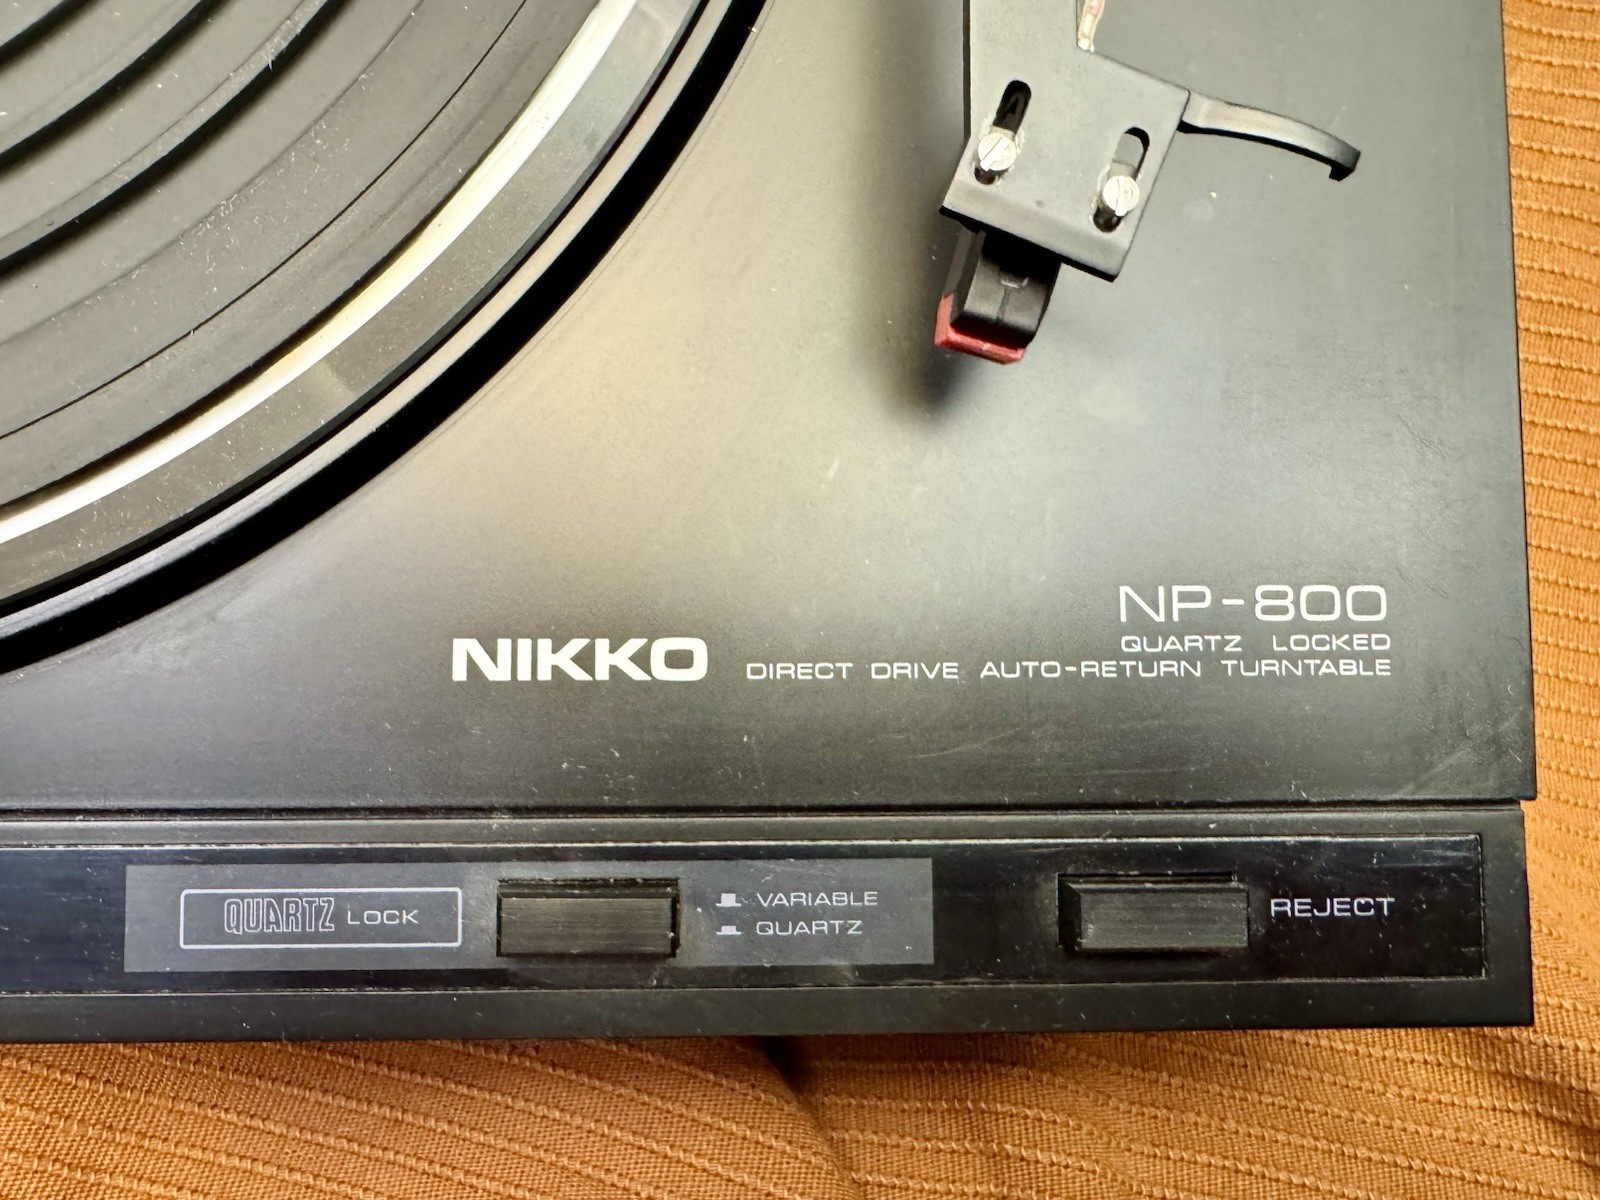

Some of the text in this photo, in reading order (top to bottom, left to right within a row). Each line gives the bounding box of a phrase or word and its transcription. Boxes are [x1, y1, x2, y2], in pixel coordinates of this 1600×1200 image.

[1118, 584, 1388, 623] NP-800
[1120, 634, 1392, 653] QUARTZ LOCKED
[451, 637, 708, 682] NIKKO
[746, 659, 1392, 680] DIRECT DRIVE AUTO-RETURN TURNTABLE
[756, 891, 879, 908] VARIABLE
[1270, 897, 1396, 918] REJECT
[223, 897, 420, 935] QUARTZ LOCK
[755, 920, 863, 936] QUARTZ
